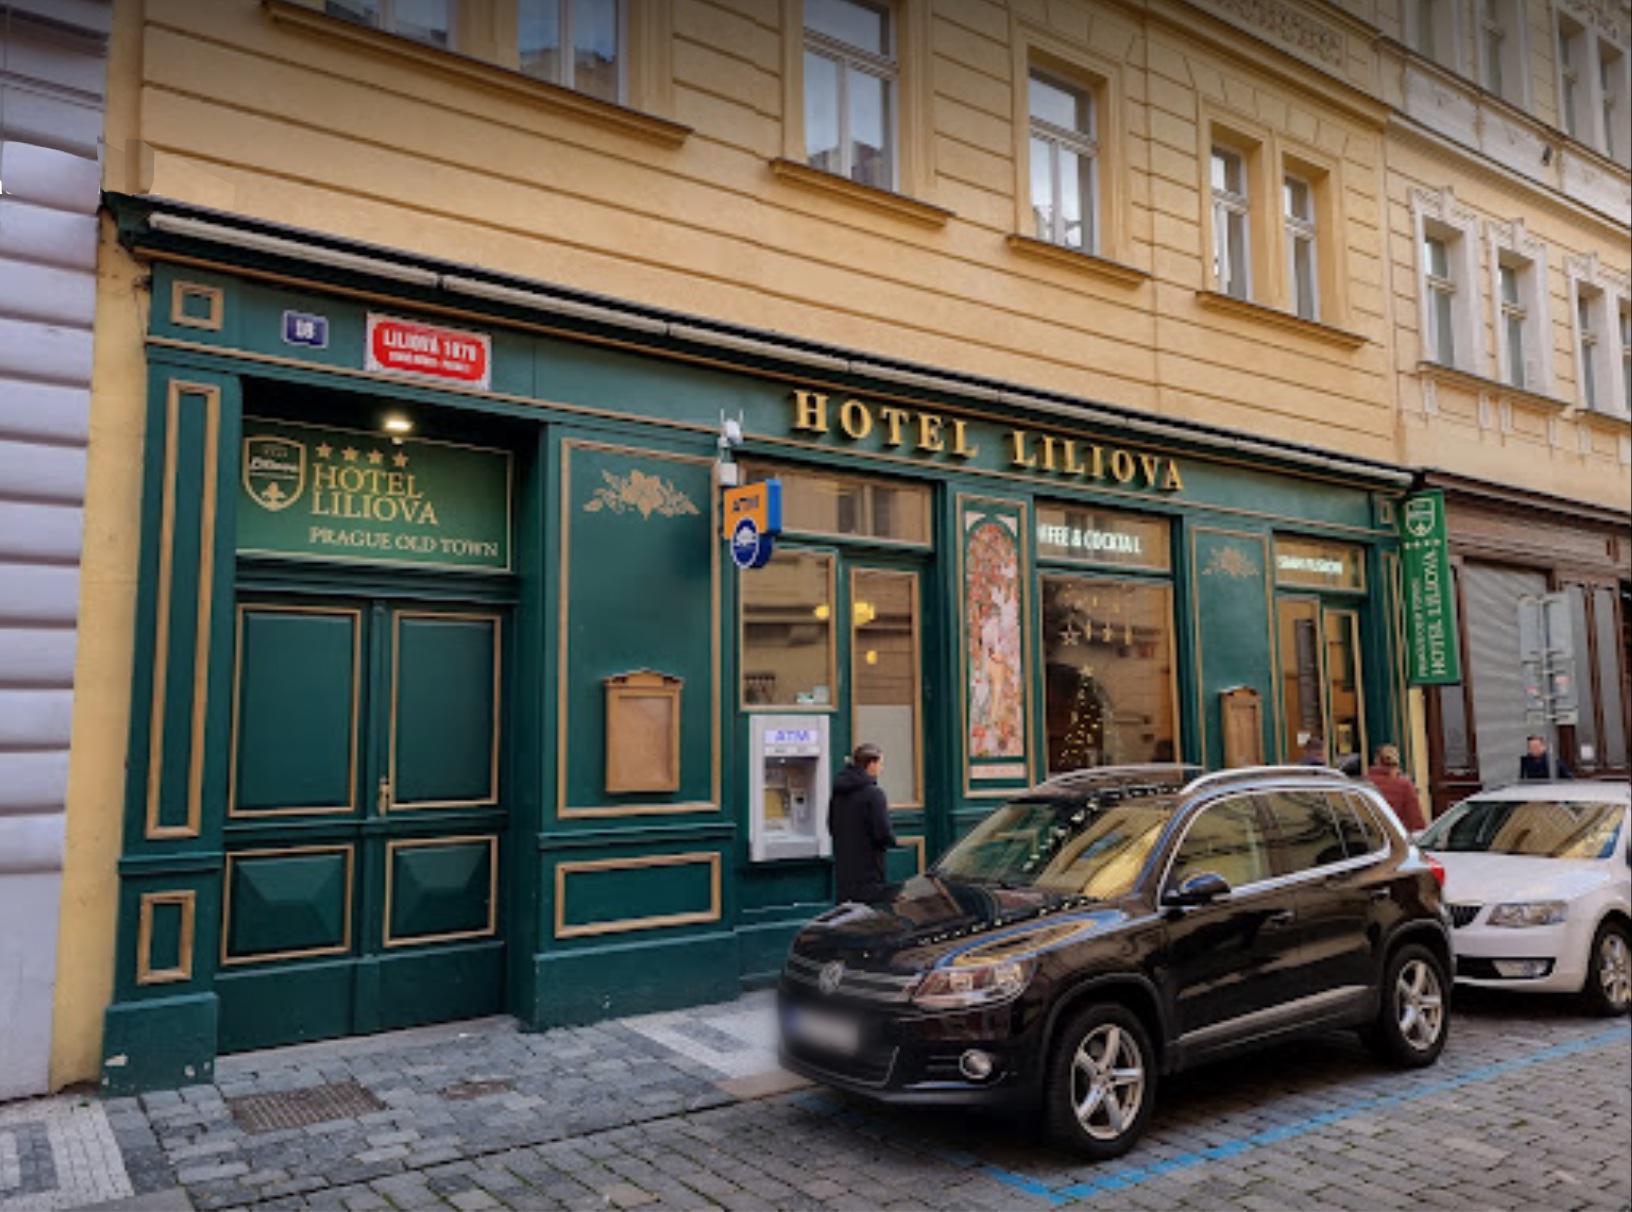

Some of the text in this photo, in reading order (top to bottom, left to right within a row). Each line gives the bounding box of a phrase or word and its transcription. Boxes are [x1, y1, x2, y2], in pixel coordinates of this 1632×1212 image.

[791, 388, 1186, 492] HOTEL LILIOVA
[312, 465, 425, 498] HOTEL
[310, 490, 438, 525] LILIOVA
[309, 525, 499, 558] PRAGUE OLD TOWN
[1423, 549, 1446, 676] HOTEL LILIOVA
[775, 729, 810, 742] ATM
